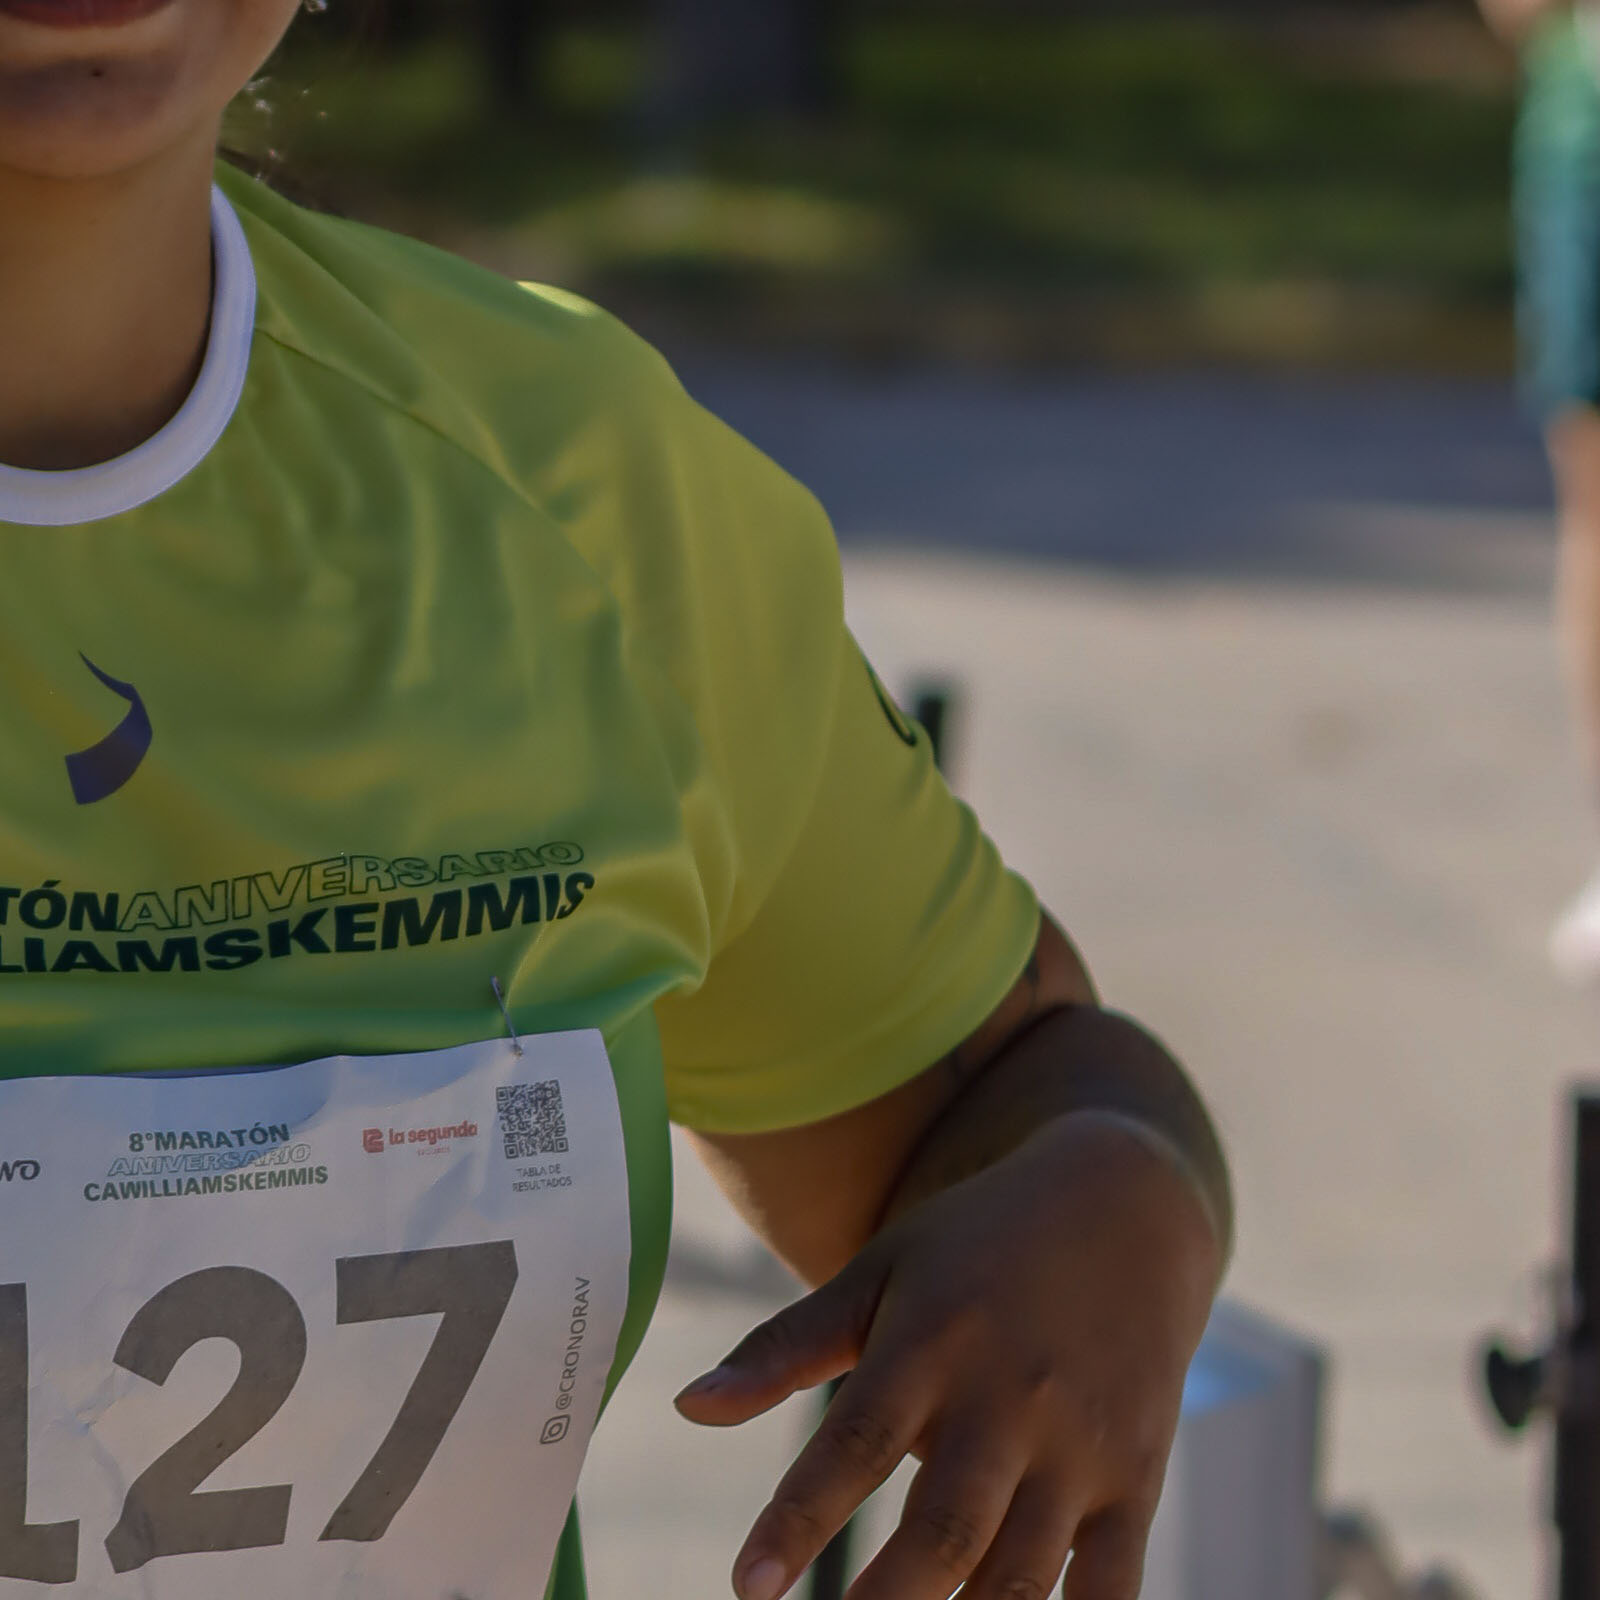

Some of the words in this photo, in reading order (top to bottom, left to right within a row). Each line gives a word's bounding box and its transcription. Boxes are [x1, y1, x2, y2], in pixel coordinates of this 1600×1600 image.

[388, 1128, 405, 1146] la
[407, 1119, 479, 1146] segunda
[106, 1143, 312, 1177] ANIVERSARIO
[515, 1165, 547, 1178] TABLA
[548, 1163, 561, 1175] DE
[83, 1165, 329, 1202] CAWILLIAMSKEMMIS
[512, 1175, 573, 1192] RESULTADOS
[555, 1276, 591, 1411] @CRONORAV
